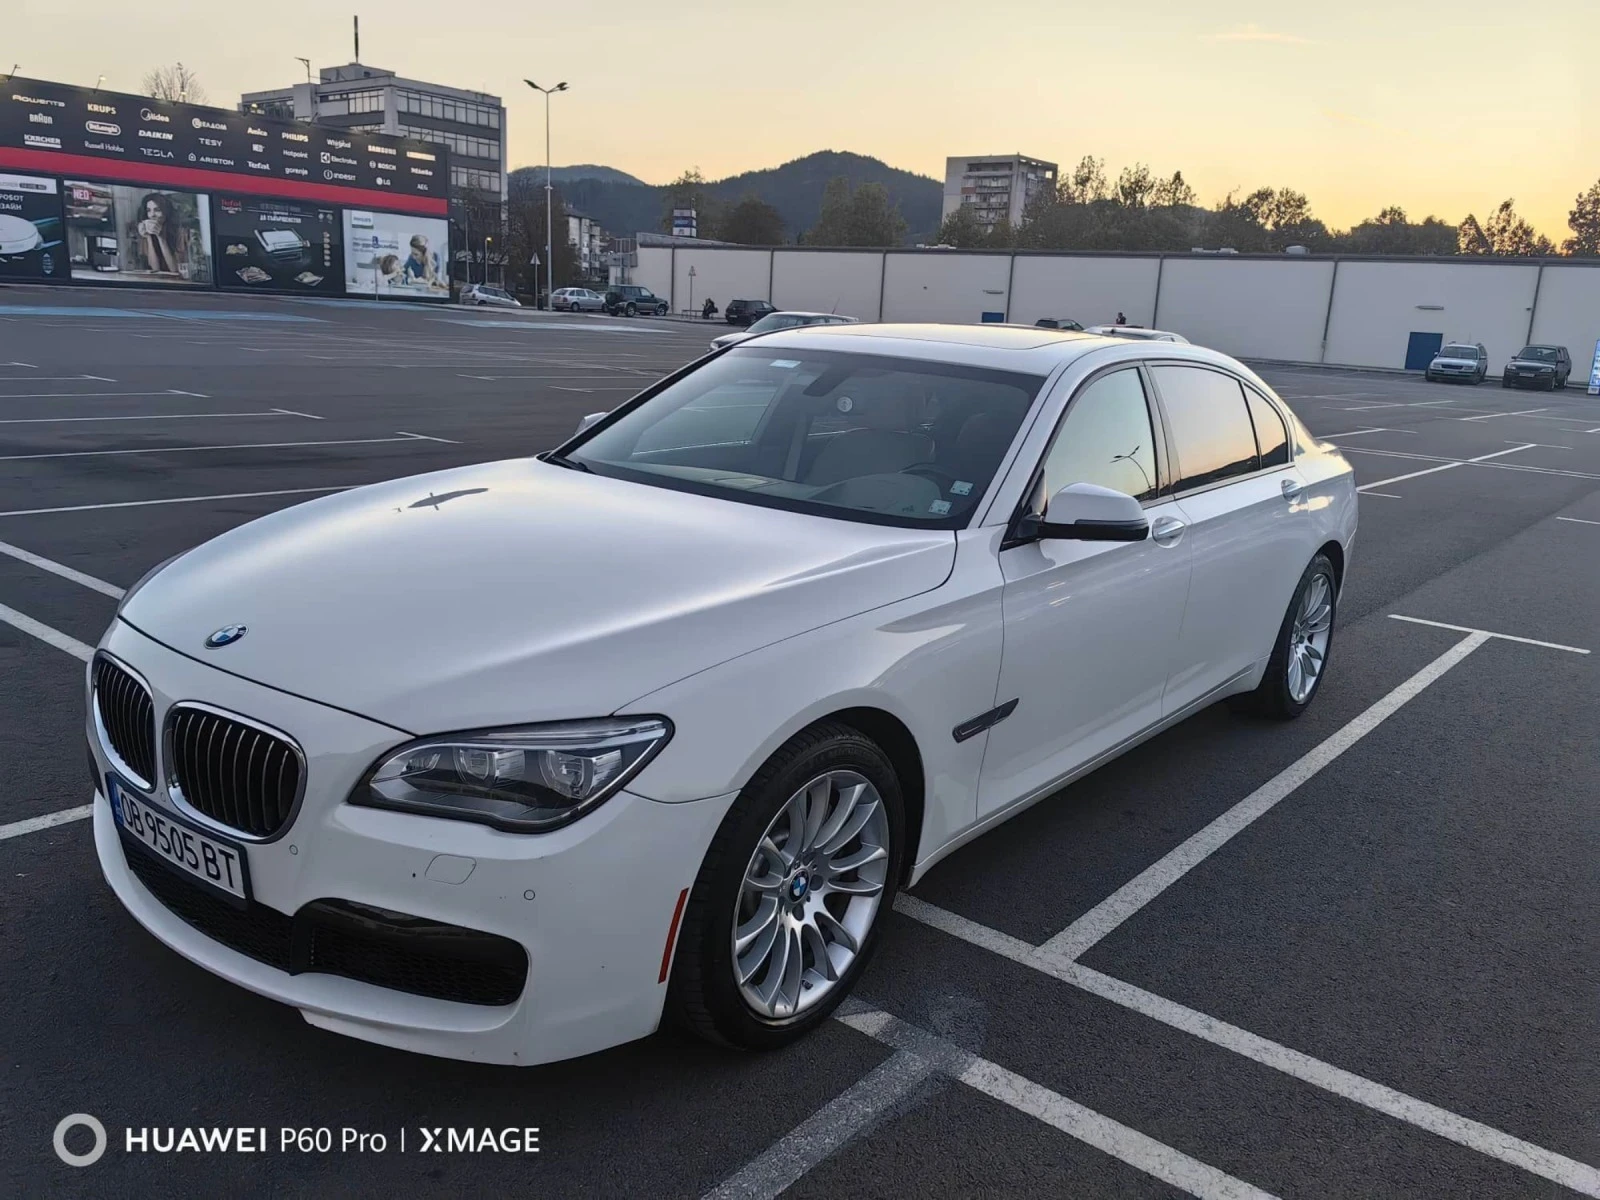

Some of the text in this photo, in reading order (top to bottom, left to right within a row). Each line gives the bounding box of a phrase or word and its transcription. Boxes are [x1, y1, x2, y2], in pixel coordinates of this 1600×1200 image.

[87, 103, 117, 115] KRUPS
[29, 112, 53, 125] BRAUN
[138, 129, 174, 141] DAIKIN
[281, 132, 309, 143] PHILIPS
[84, 140, 125, 153] Russell Hobbs
[198, 137, 223, 147] TESY
[139, 147, 174, 159] TESLA
[283, 149, 309, 159] Hotpoint
[367, 144, 397, 156] SAMSUNG
[199, 156, 234, 166] ARISTON
[377, 162, 397, 171] BOSCH
[285, 166, 309, 177] gorenje
[382, 178, 391, 186] LG
[416, 183, 429, 191] AEG
[73, 188, 90, 201] NEO
[144, 813, 199, 870] 9505
[201, 841, 235, 889] BT
